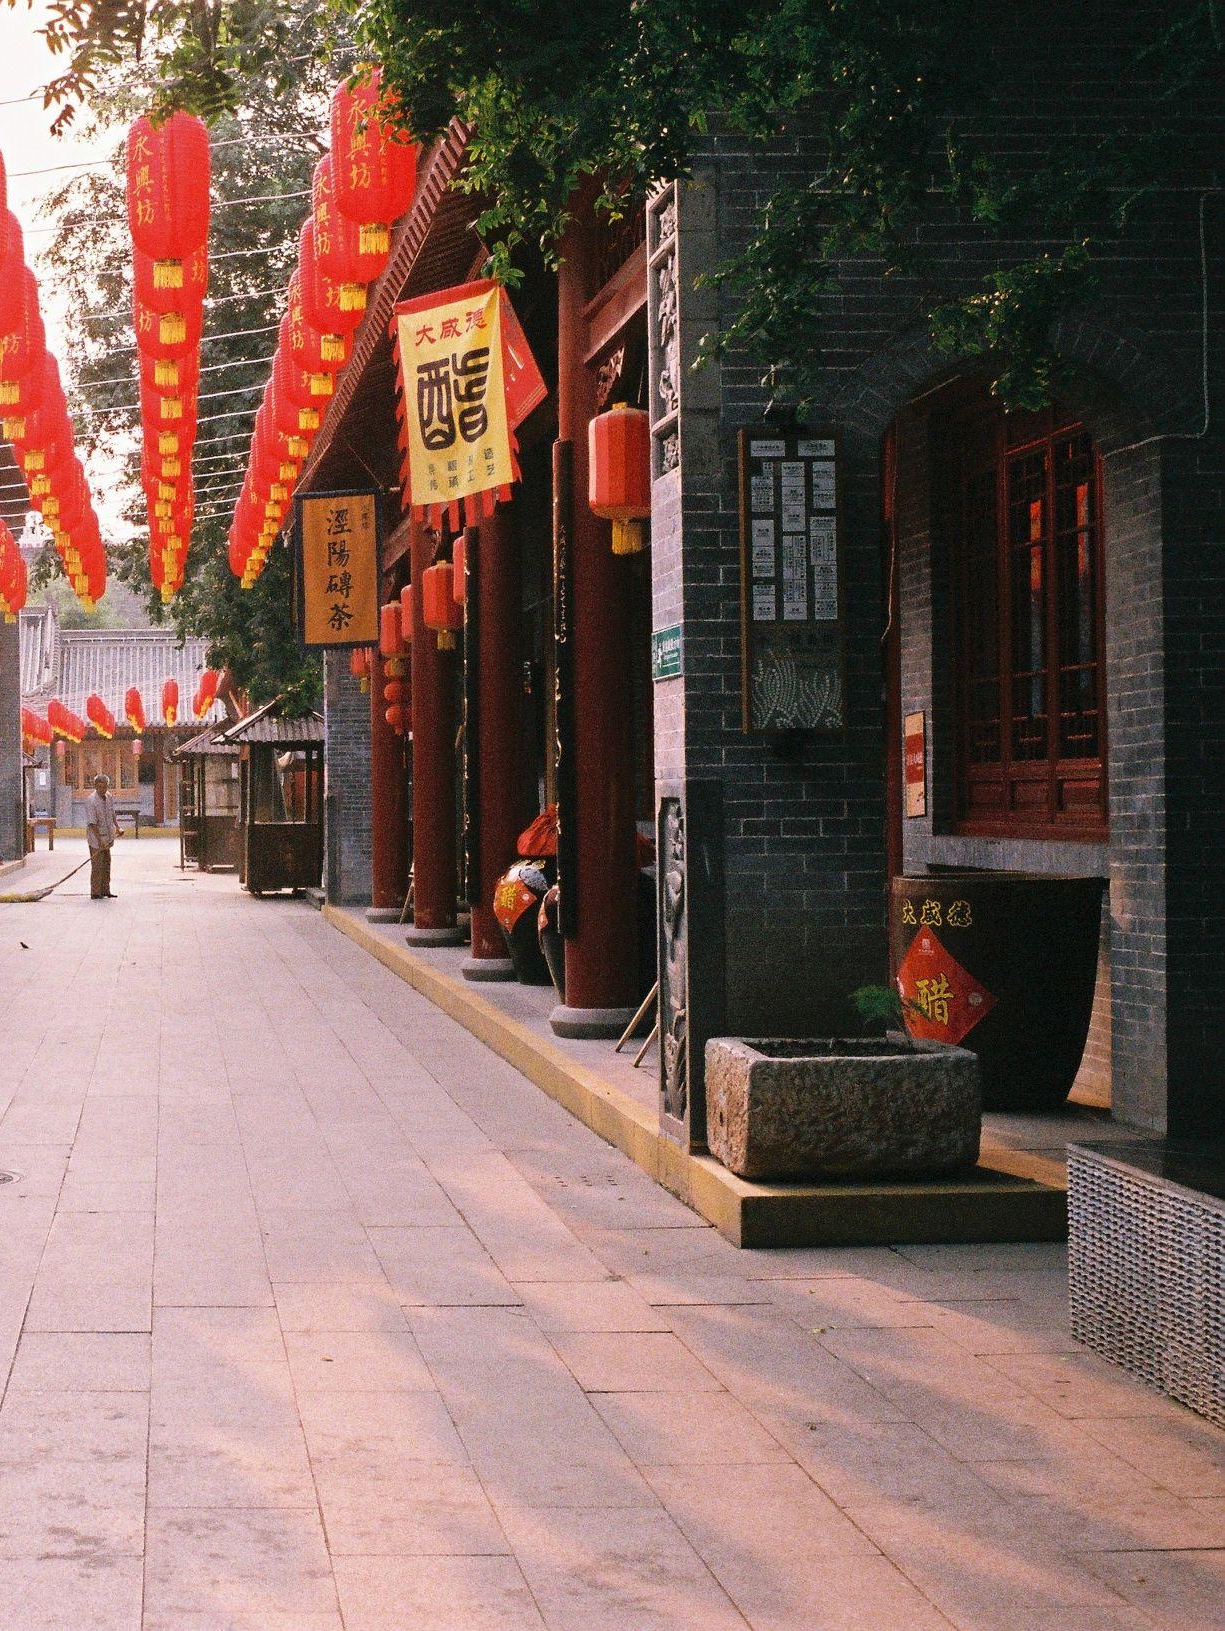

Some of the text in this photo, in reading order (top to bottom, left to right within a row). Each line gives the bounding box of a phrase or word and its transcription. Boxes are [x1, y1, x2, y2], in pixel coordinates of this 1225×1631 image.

[133, 131, 158, 226] 永興坊
[915, 972, 954, 1025] 醋
